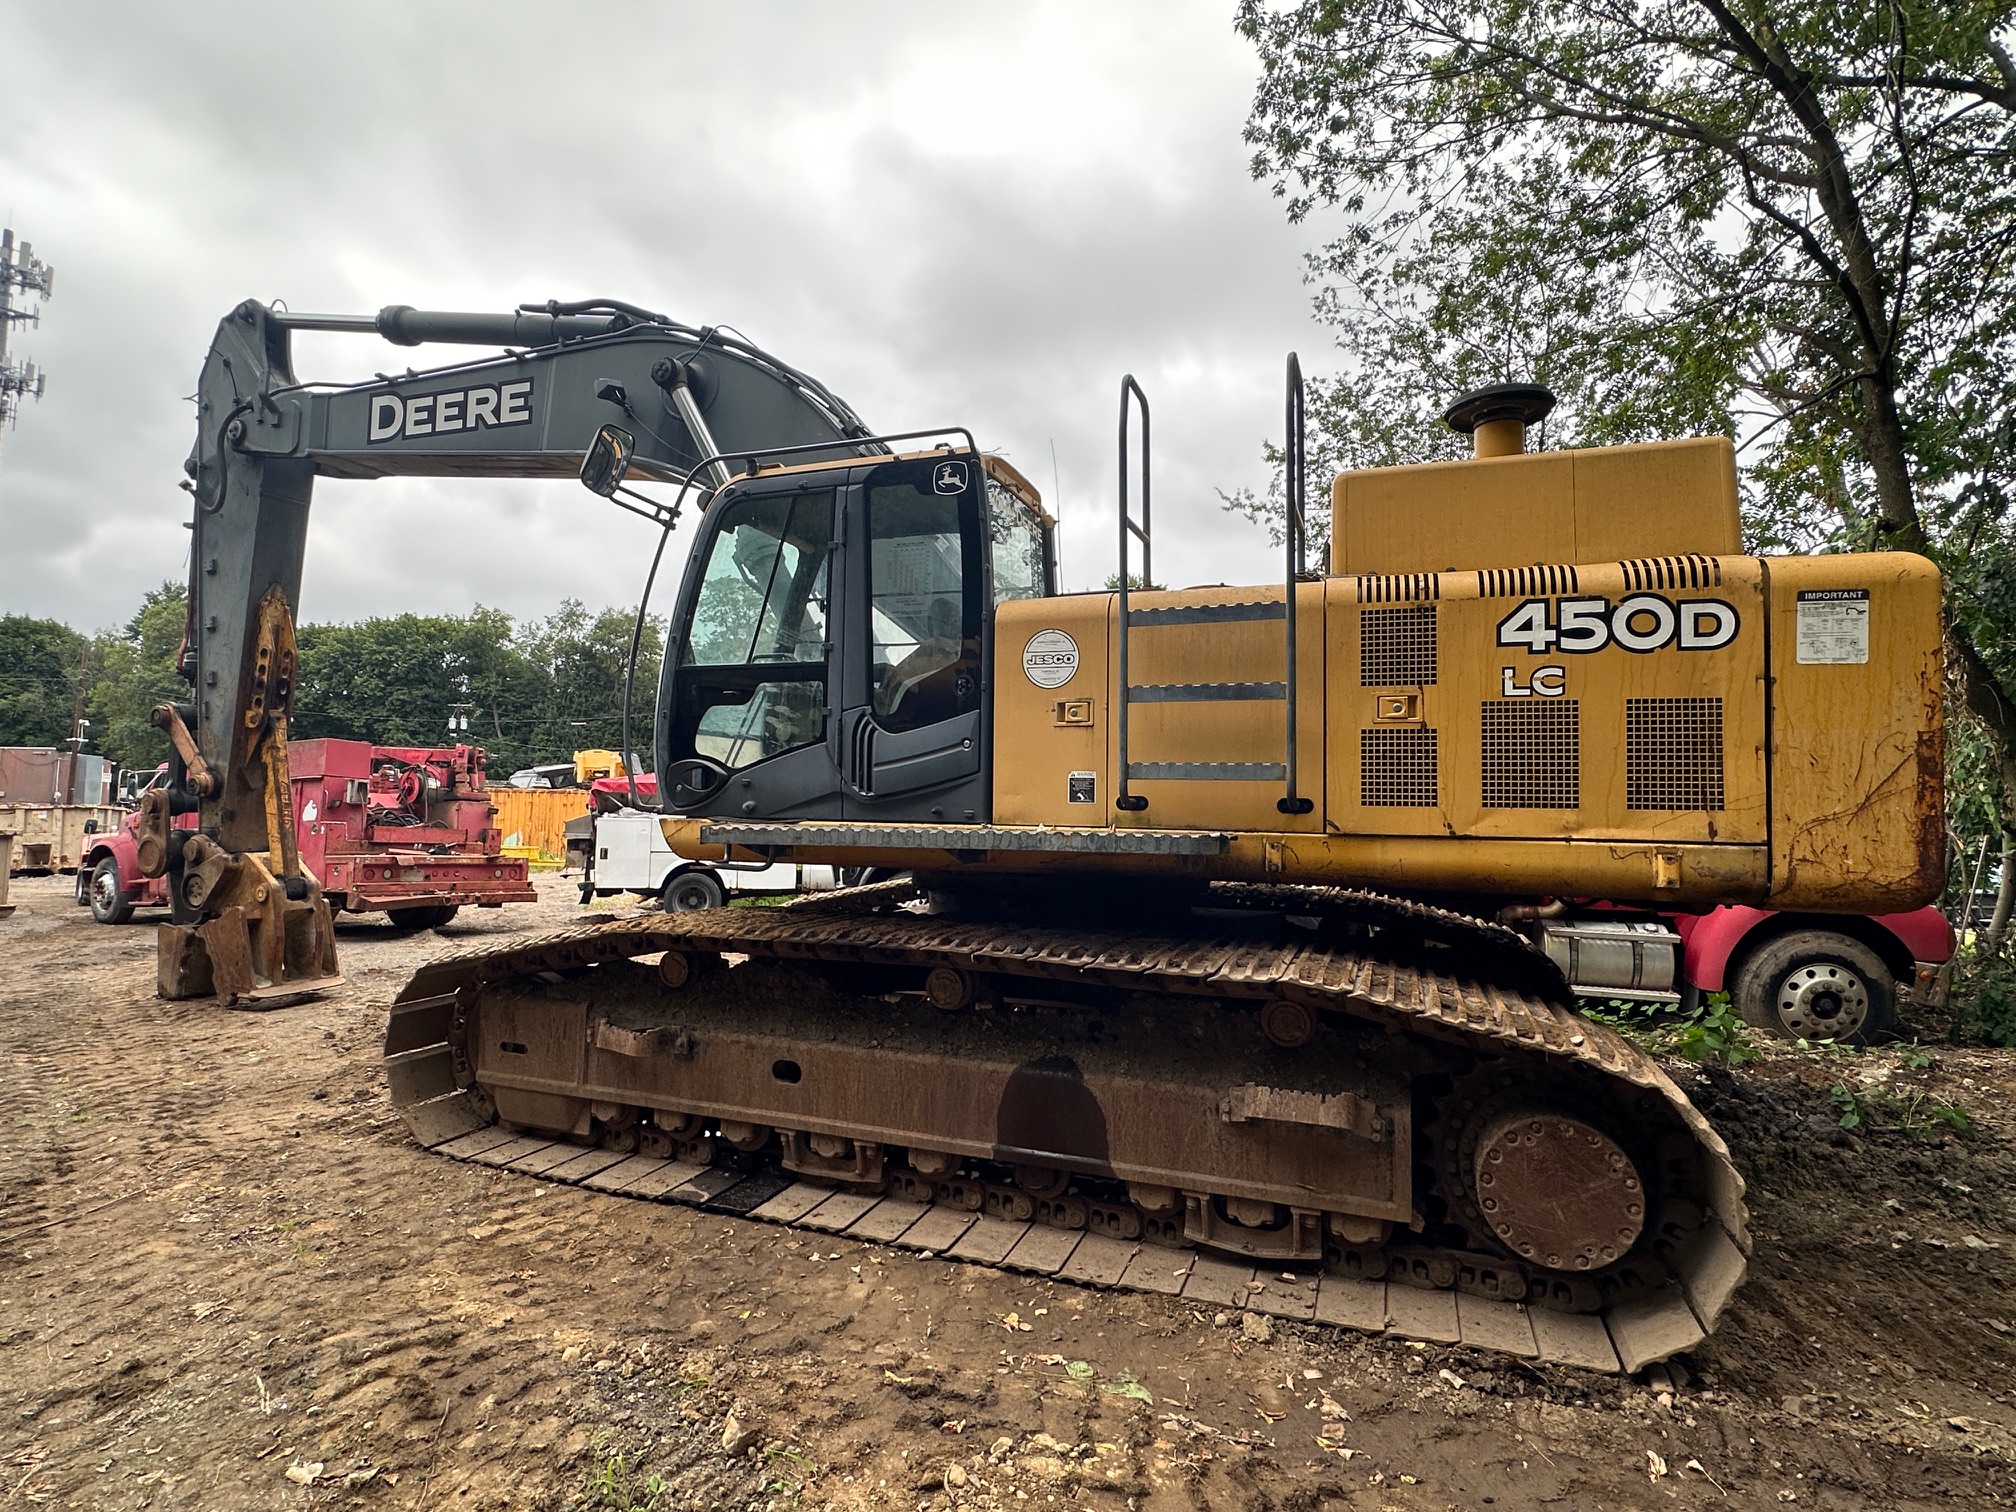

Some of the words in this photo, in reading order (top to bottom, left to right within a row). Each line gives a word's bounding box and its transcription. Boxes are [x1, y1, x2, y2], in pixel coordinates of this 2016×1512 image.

[369, 381, 531, 441] DEERE
[1804, 591, 1863, 600] IMPORTANT
[1498, 594, 1739, 653] 450D
[1027, 654, 1075, 665] JESCO
[1502, 666, 1565, 697] LC
